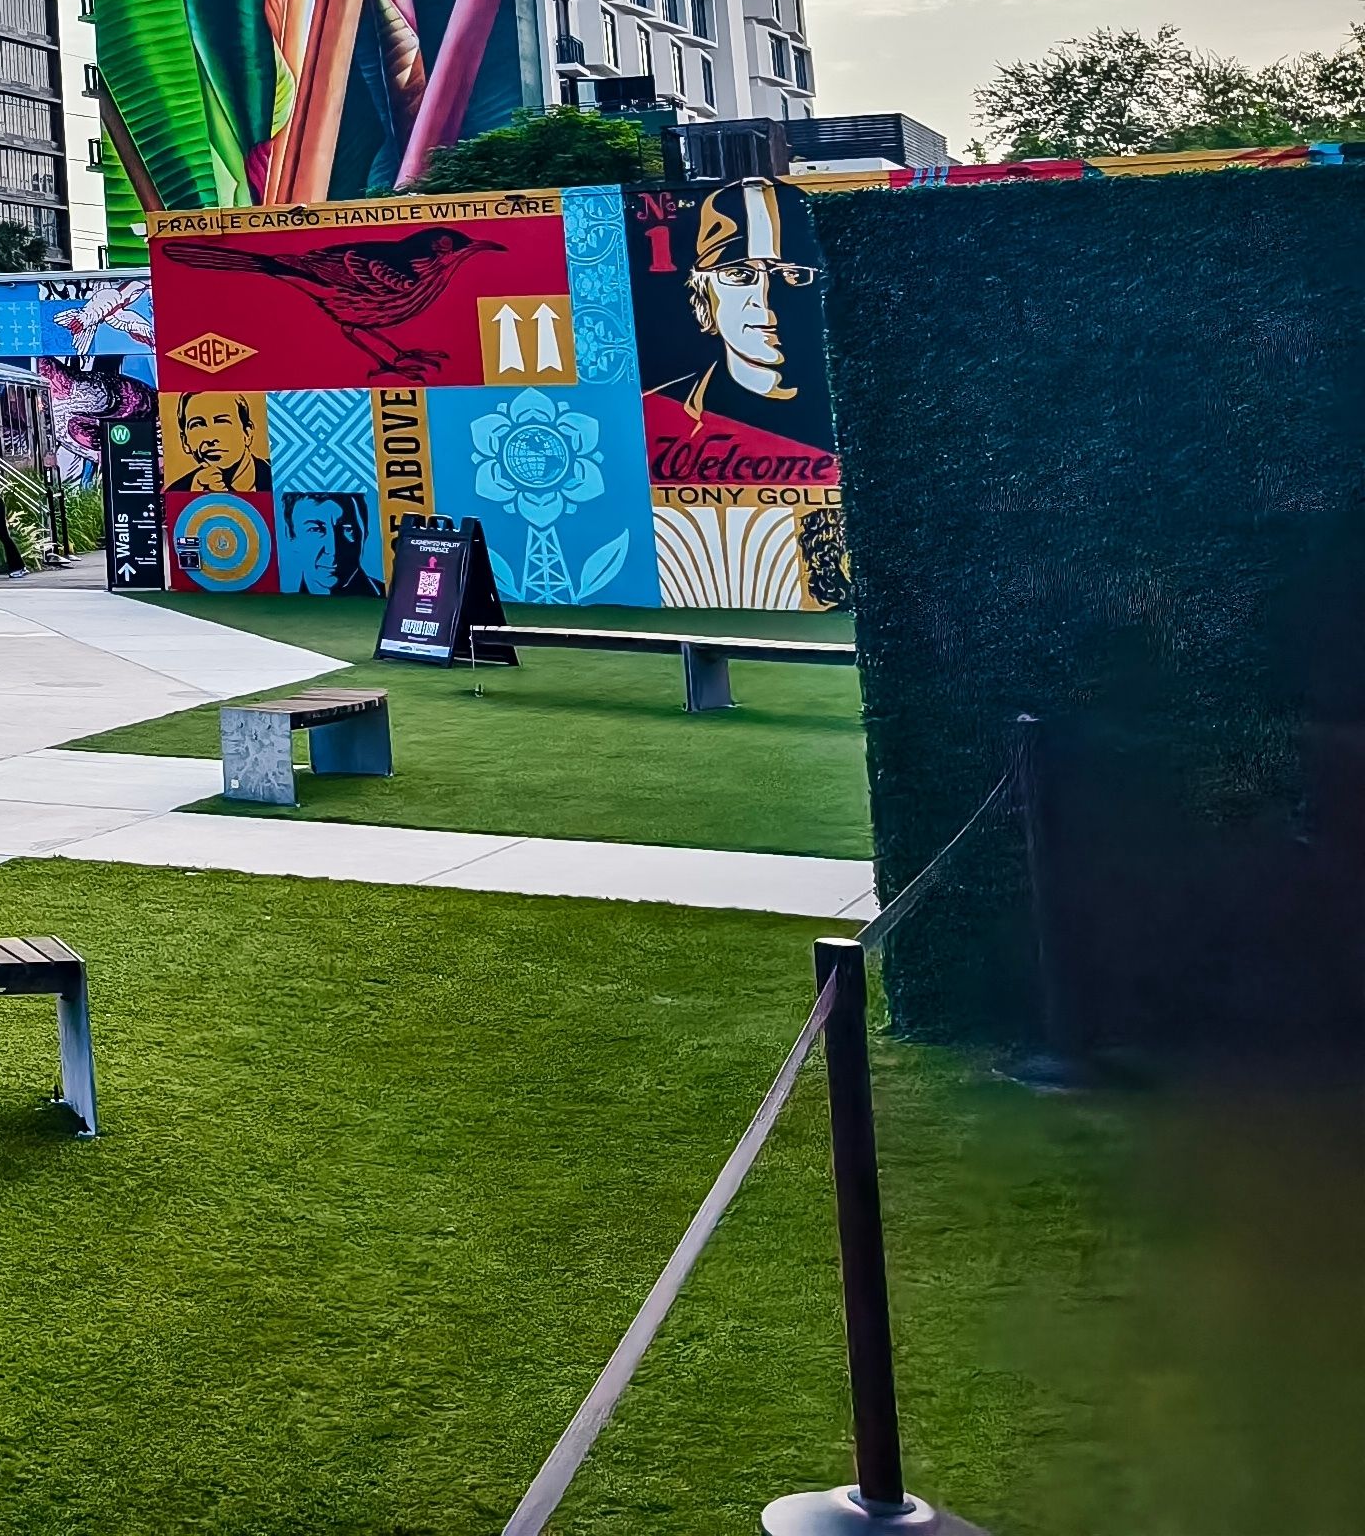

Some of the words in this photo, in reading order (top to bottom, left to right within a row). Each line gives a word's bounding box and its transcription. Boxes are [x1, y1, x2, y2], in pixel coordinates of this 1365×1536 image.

[157, 215, 242, 233] FRAGILE
[428, 202, 488, 219] WITH
[494, 199, 556, 215] CARE
[645, 225, 677, 272] 1
[183, 338, 240, 367] OBEY
[113, 428, 128, 442] W
[380, 389, 425, 506] ABOVE
[651, 433, 837, 482] Welcome
[656, 486, 745, 505] TONY
[756, 486, 842, 506] GOLD
[114, 513, 131, 559] Walls
